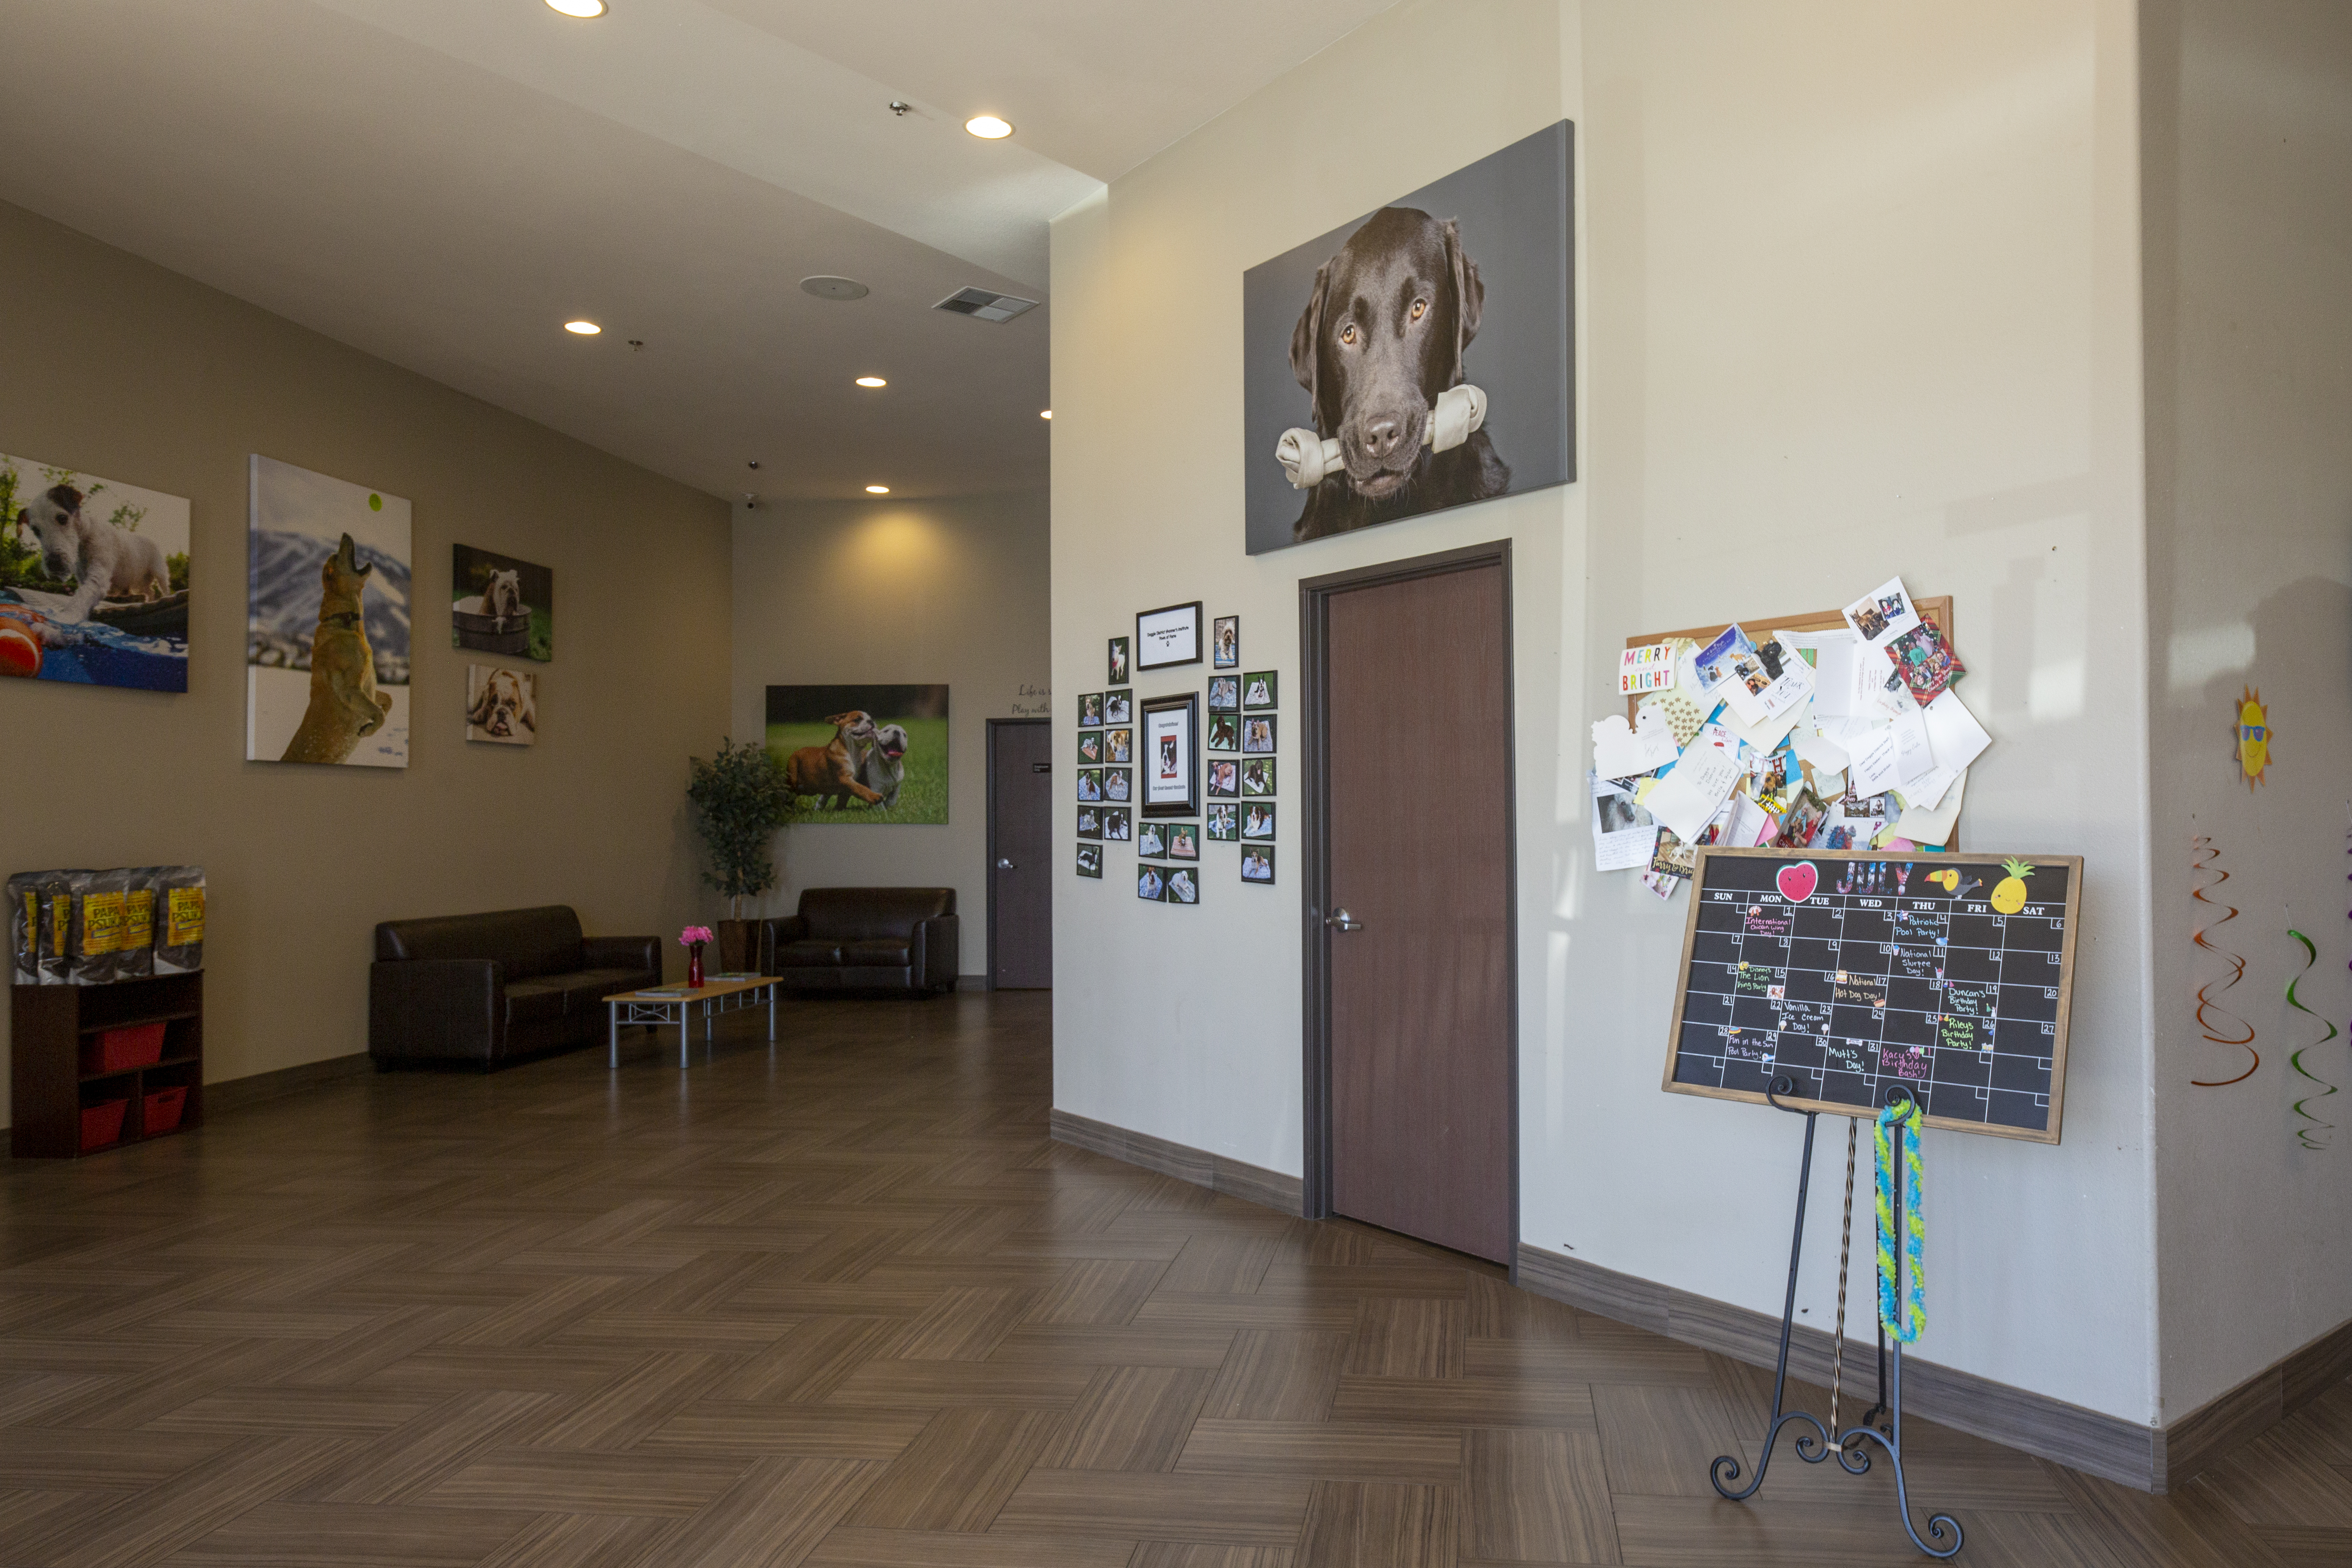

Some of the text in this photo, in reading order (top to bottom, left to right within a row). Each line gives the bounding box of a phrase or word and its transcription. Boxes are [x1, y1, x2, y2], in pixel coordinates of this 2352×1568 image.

[1624, 646, 1670, 666] MERRY
[1635, 664, 1655, 672] and
[1623, 670, 1670, 691] BRIGHT
[1652, 857, 1671, 874] Furry
[1671, 863, 1679, 872] &
[1836, 862, 1913, 895] JULY
[1714, 892, 1733, 901] SUN
[1760, 895, 1782, 903] MON
[1810, 897, 1829, 905] TUE
[1860, 899, 1882, 907] WED
[1912, 901, 1936, 910] THU
[1967, 904, 1987, 913] FRI
[2022, 906, 2045, 915] SAT
[1835, 909, 1842, 918] 2
[1886, 912, 1893, 920] 3
[1745, 917, 1791, 926] International
[1908, 915, 1939, 926] Patriotic
[1940, 914, 1947, 923] 4
[1996, 917, 2003, 925] 5
[2056, 920, 2062, 928] 6
[1895, 927, 1939, 939] Pool Party!
[1783, 938, 1788, 947] 8
[1832, 941, 1837, 949] 9
[1883, 944, 1891, 952] 10
[1937, 948, 1944, 956] 11
[1900, 948, 1931, 958] National
[1992, 951, 2000, 960] 12
[2051, 954, 2060, 962] 13
[1902, 958, 1931, 968] Slurpee
[1729, 964, 1737, 973] 14
[1906, 967, 1924, 977] Day!
[1739, 971, 1770, 982] The Lion
[1849, 975, 1876, 986] National
[1737, 981, 1766, 992] King Party
[1835, 987, 1880, 1002] Hot Dog Day!
[1948, 987, 1986, 998] Duncan's
[2047, 989, 2057, 997] 20
[1772, 1001, 1781, 1009] 22
[1948, 996, 1977, 1006] Birthday
[1784, 1001, 1811, 1012] Vanilla
[1822, 1005, 1832, 1013] 23
[1954, 1003, 1979, 1016] Party!
[1782, 1012, 1795, 1020] Ice
[1874, 1010, 1883, 1018] 24
[1927, 1015, 1937, 1023] 25
[1793, 1022, 1810, 1033] Day!
[1949, 1018, 1974, 1033] Riley's
[1984, 1020, 1995, 1029] 26
[1719, 1027, 1728, 1035] 28
[2044, 1025, 2054, 1034] 27
[1768, 1031, 1777, 1041] 29
[1941, 1029, 1973, 1041] Birthday
[1728, 1034, 1740, 1045] Fun
[1752, 1038, 1762, 1047] the
[1818, 1038, 1827, 1046] 30
[1946, 1038, 1972, 1050] Party!
[1870, 1042, 1878, 1051] 31
[1728, 1047, 1762, 1060] Pool Party!
[1829, 1047, 1858, 1059] Mutt's
[1883, 1048, 1912, 1069] Kacy's
[1845, 1060, 1864, 1073] Day!
[1882, 1058, 1927, 1078] Birthday
[1898, 1069, 1920, 1078] Bash!
